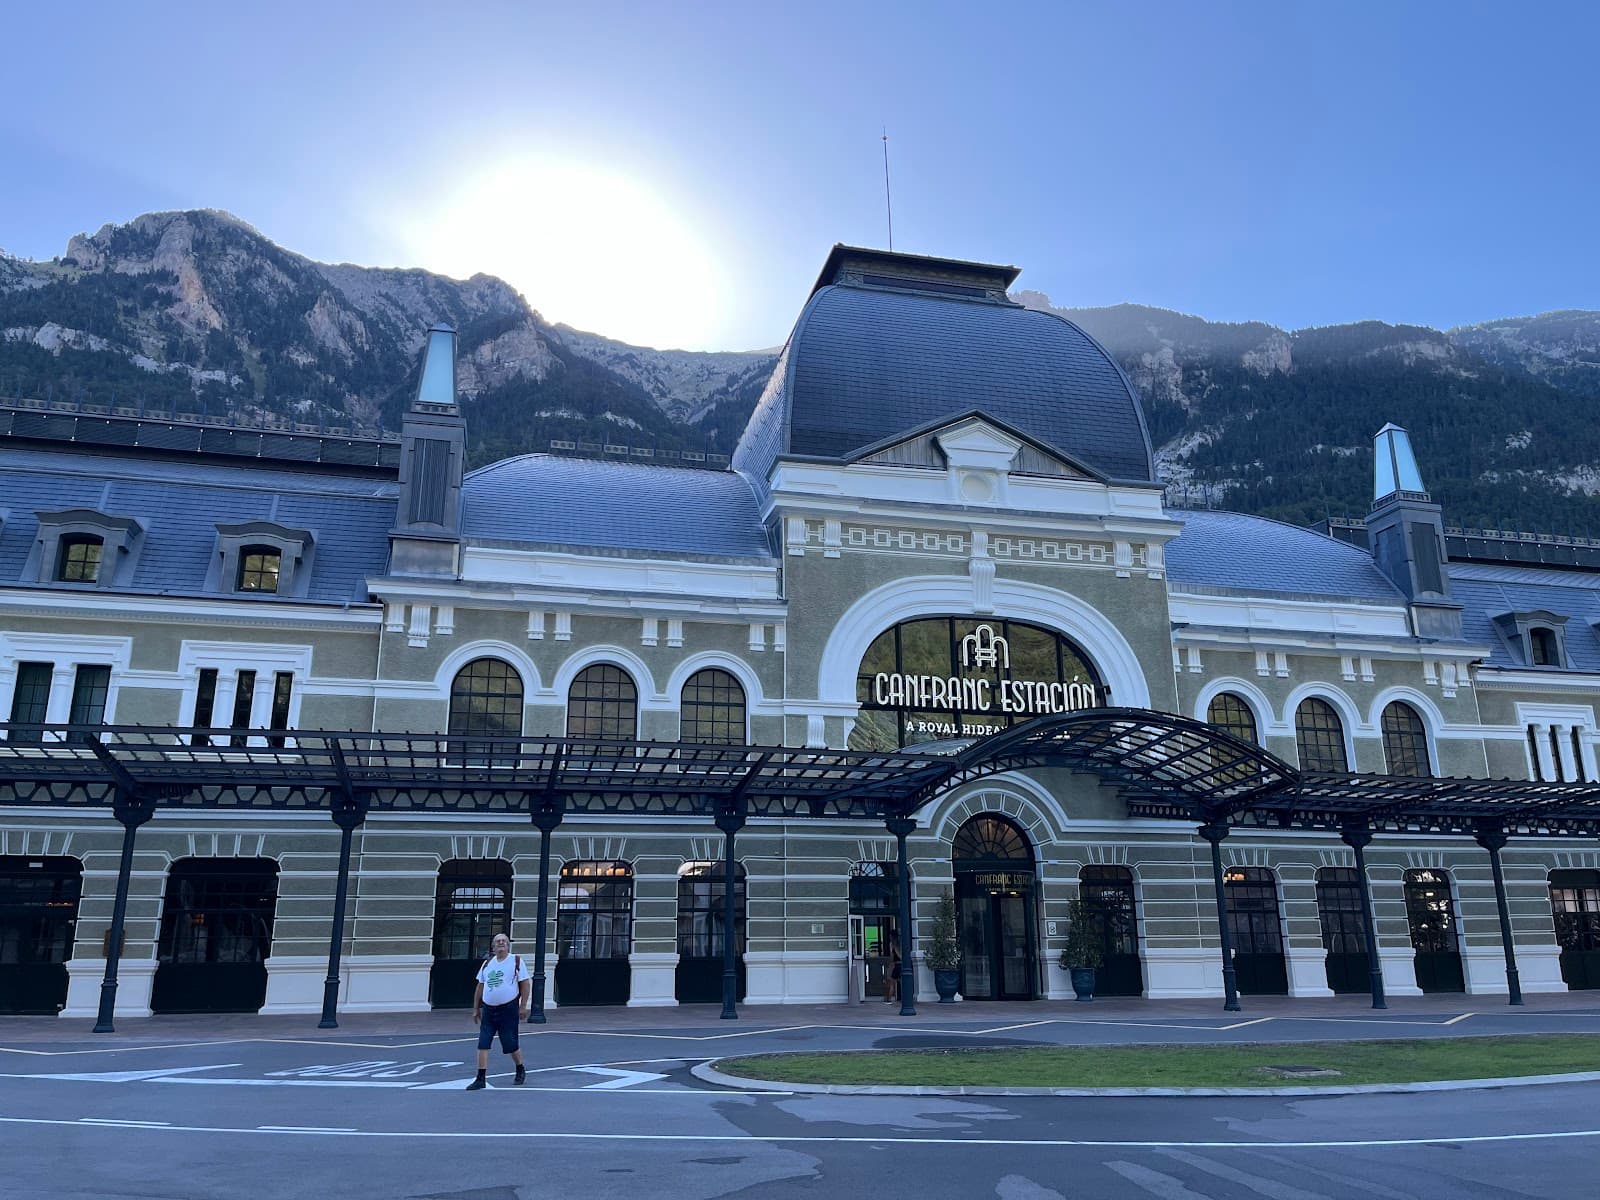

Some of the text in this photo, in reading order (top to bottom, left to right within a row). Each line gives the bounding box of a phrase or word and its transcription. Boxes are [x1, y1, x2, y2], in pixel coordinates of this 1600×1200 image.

[876, 672, 1096, 714] CANFRANC ESTACIÓN
[906, 721, 1008, 736] A ROYAL HIDEA
